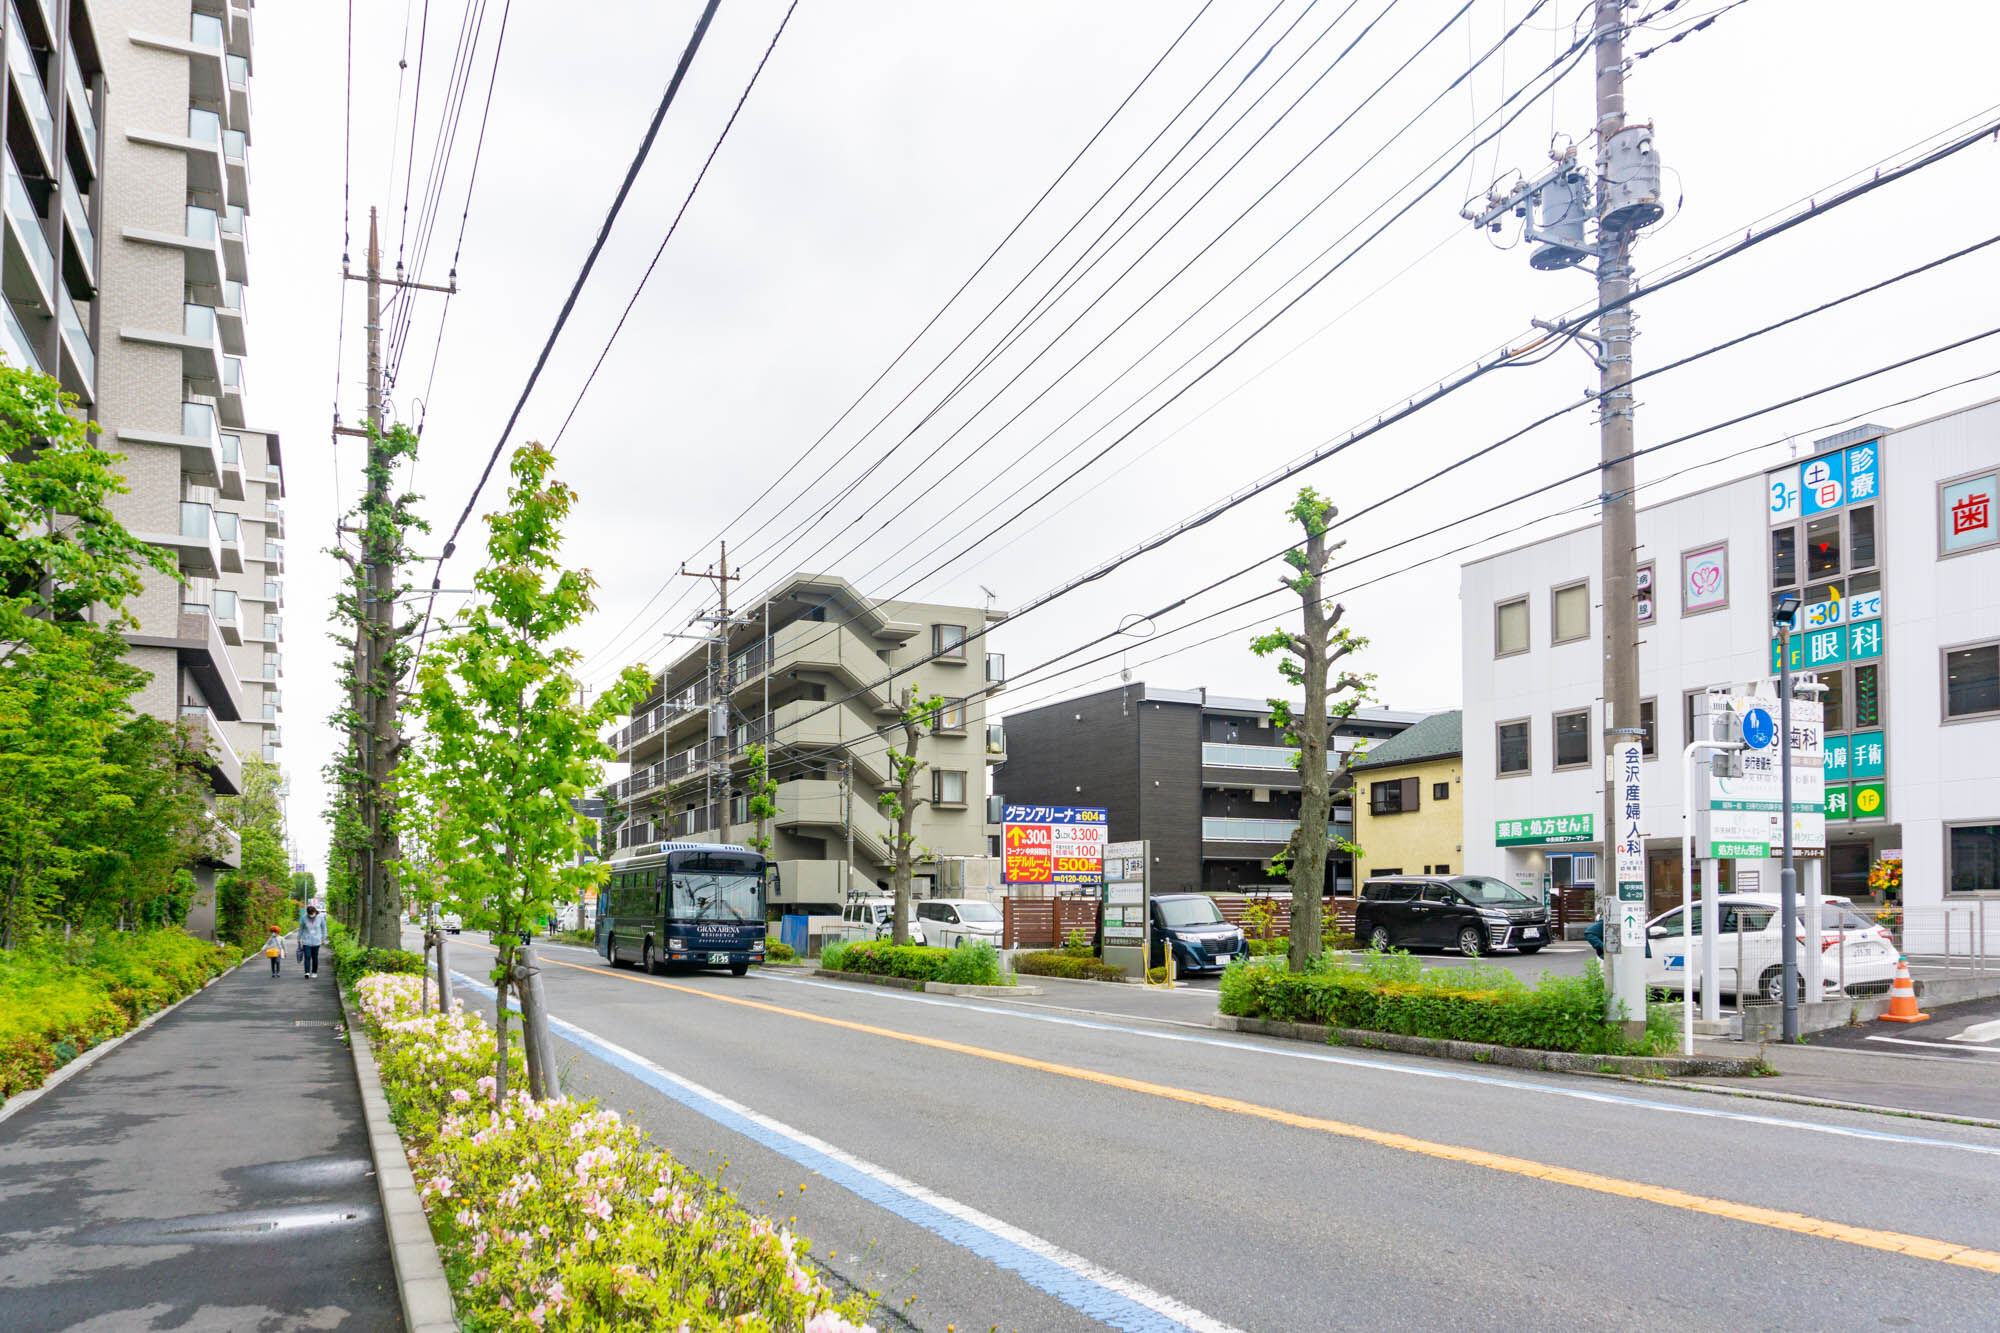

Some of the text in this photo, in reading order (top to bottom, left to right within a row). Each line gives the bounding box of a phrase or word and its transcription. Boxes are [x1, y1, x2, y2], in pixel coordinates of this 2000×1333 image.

[1850, 447, 1875, 499] 診療
[1771, 482, 1798, 512] 3F
[1951, 492, 1990, 536] 歯
[1851, 597, 1881, 618] まで
[1811, 623, 1881, 663] 眼科
[1625, 747, 1641, 857] 会沢産婦人科
[1861, 794, 1876, 806] 1F
[1006, 806, 1074, 822] グランアリーナ
[1498, 817, 1581, 838] 薬局・処方せん
[1718, 844, 1763, 857] 処方せん受付
[1007, 856, 1050, 868] モデルルーム
[1009, 868, 1049, 880] オープン
